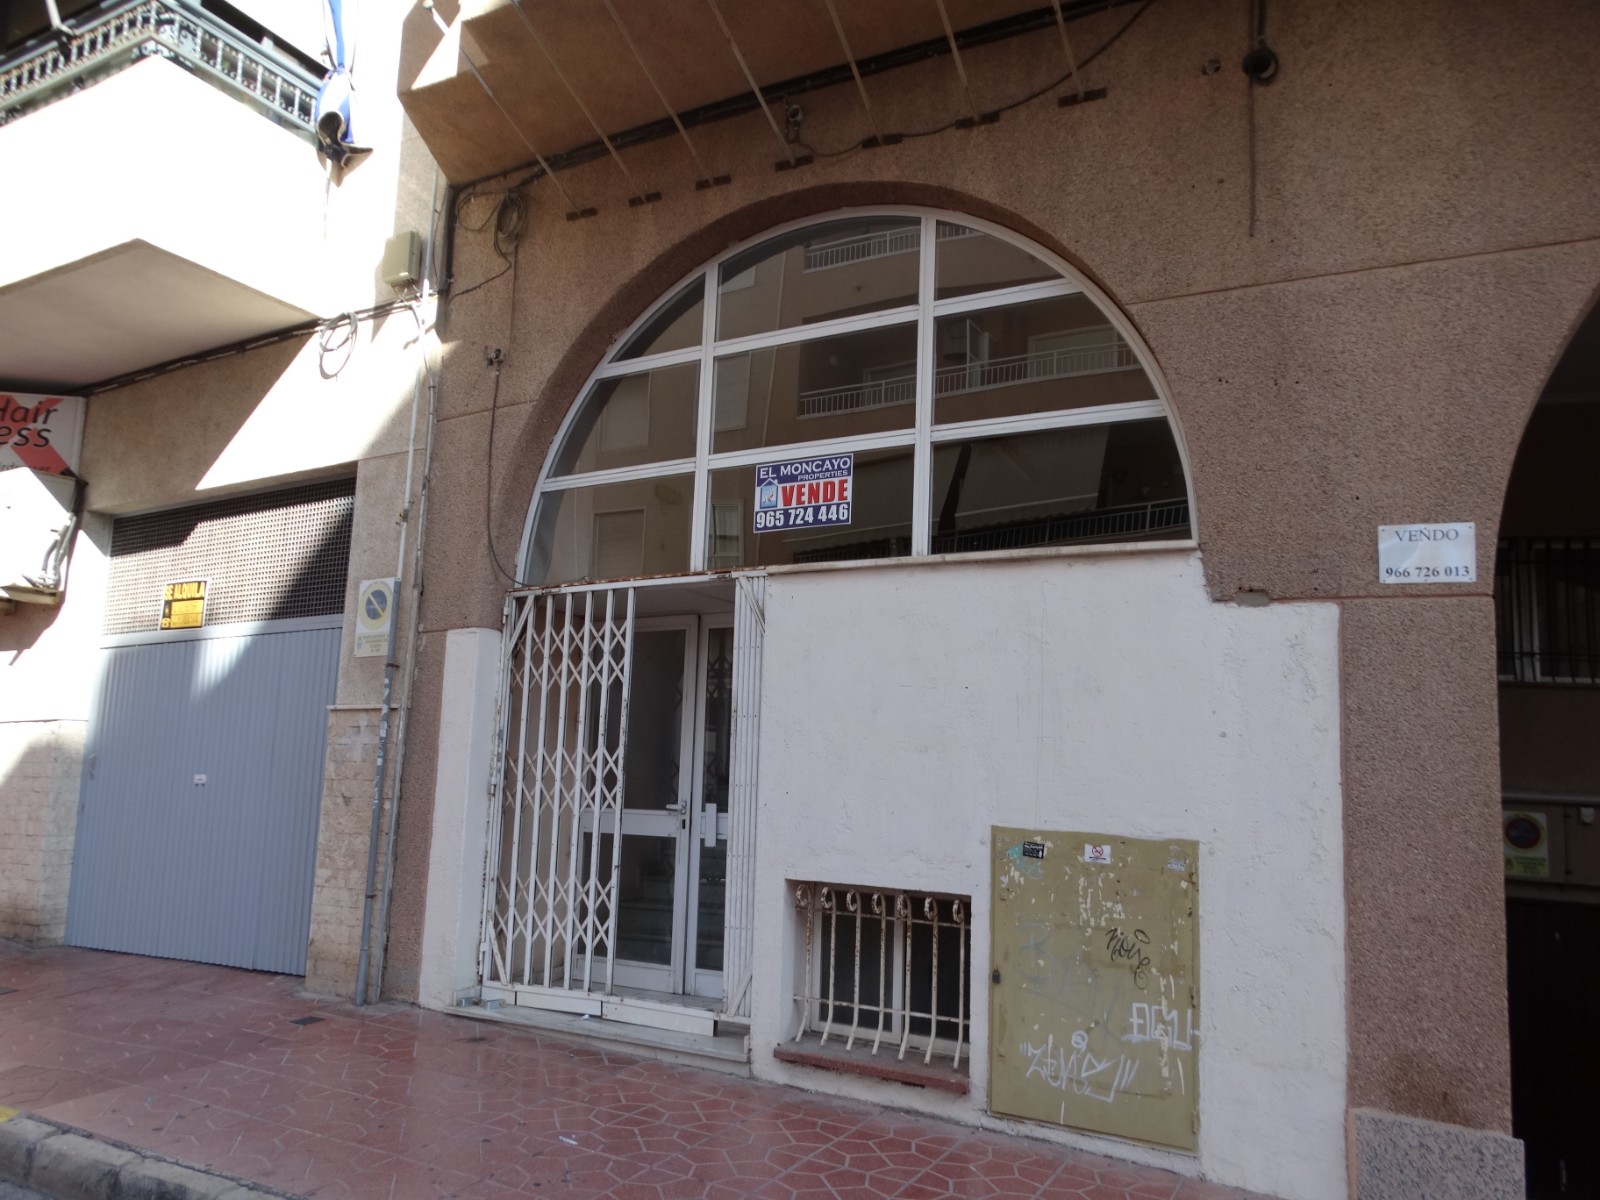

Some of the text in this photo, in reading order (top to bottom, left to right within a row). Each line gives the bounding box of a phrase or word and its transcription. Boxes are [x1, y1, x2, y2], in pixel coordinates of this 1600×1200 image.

[760, 457, 851, 479] EL MONCAYO
[797, 469, 848, 482] PROPERTIES
[781, 479, 848, 507] VENDE
[756, 503, 849, 529] 965 724 446
[1394, 528, 1459, 542] VENDO
[1385, 565, 1470, 578] 966 726 013
[173, 582, 205, 599] ALQUILA
